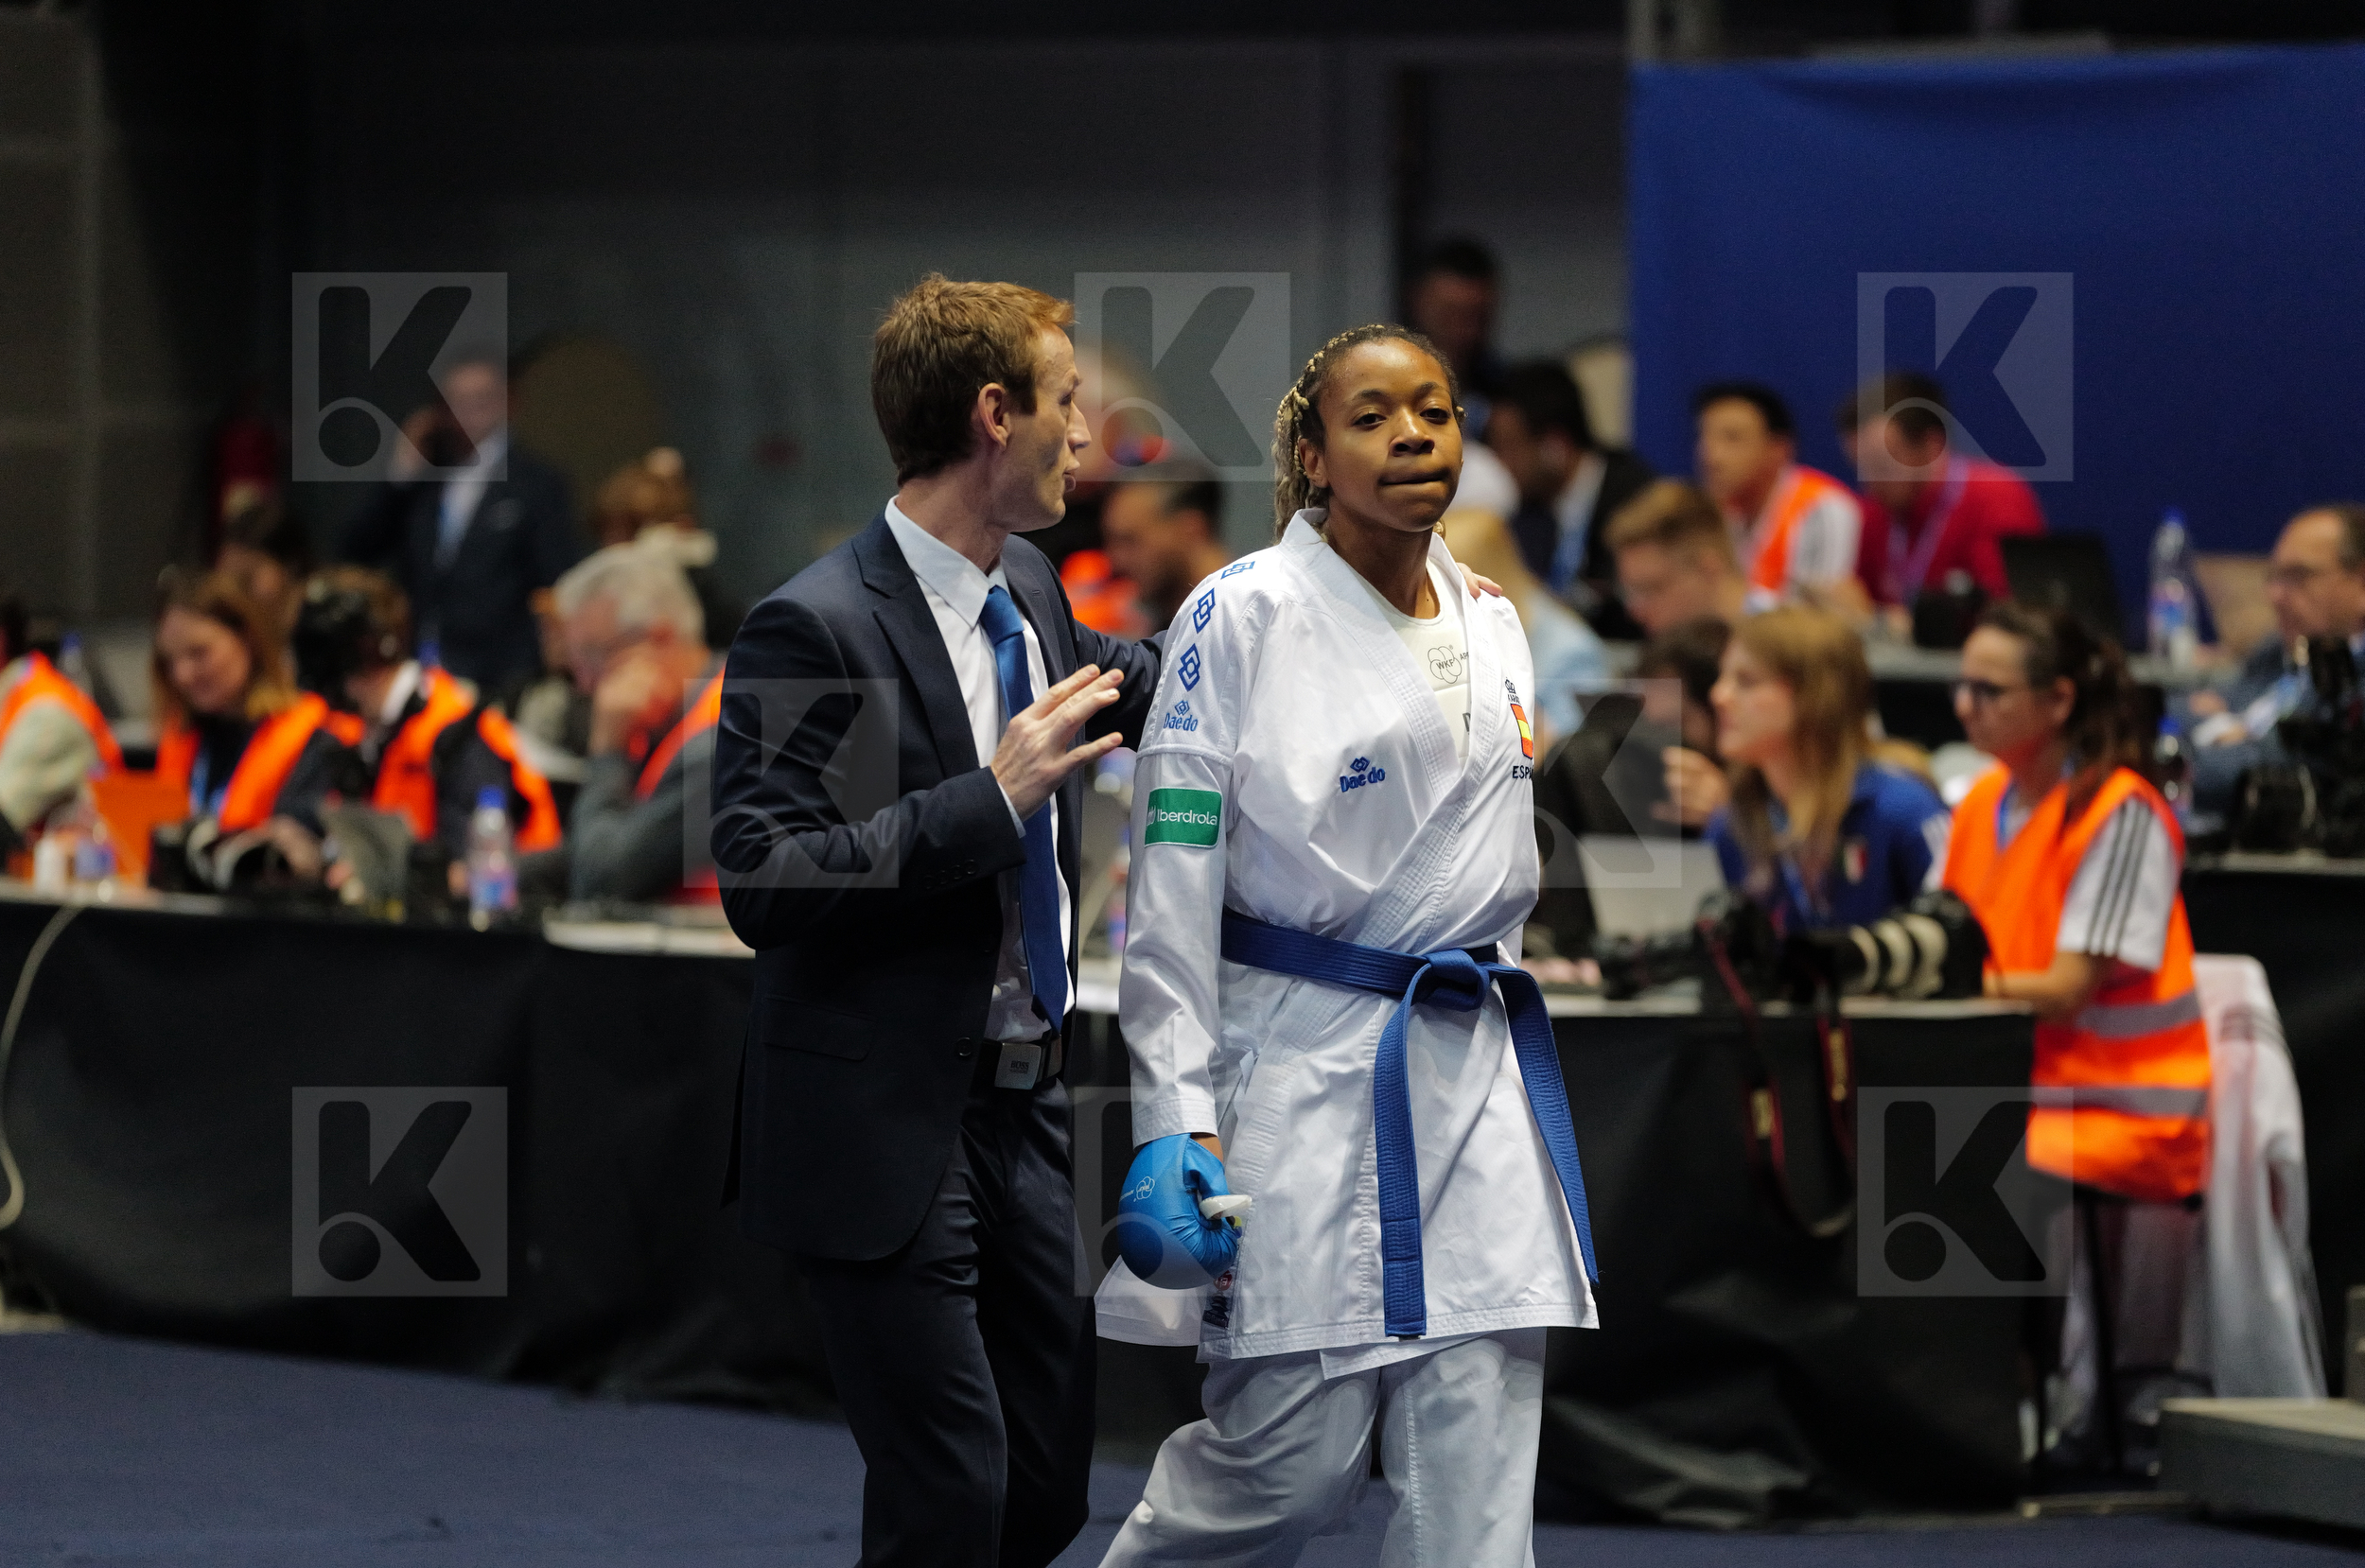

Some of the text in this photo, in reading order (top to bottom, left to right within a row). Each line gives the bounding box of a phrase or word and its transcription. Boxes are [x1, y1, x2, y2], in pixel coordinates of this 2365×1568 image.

[1436, 659, 1454, 671] WKF
[1163, 713, 1199, 732] Daedo
[1340, 767, 1386, 793] Daedo
[1157, 809, 1218, 827] Iberdrola
[1010, 1060, 1030, 1070] BOSS
